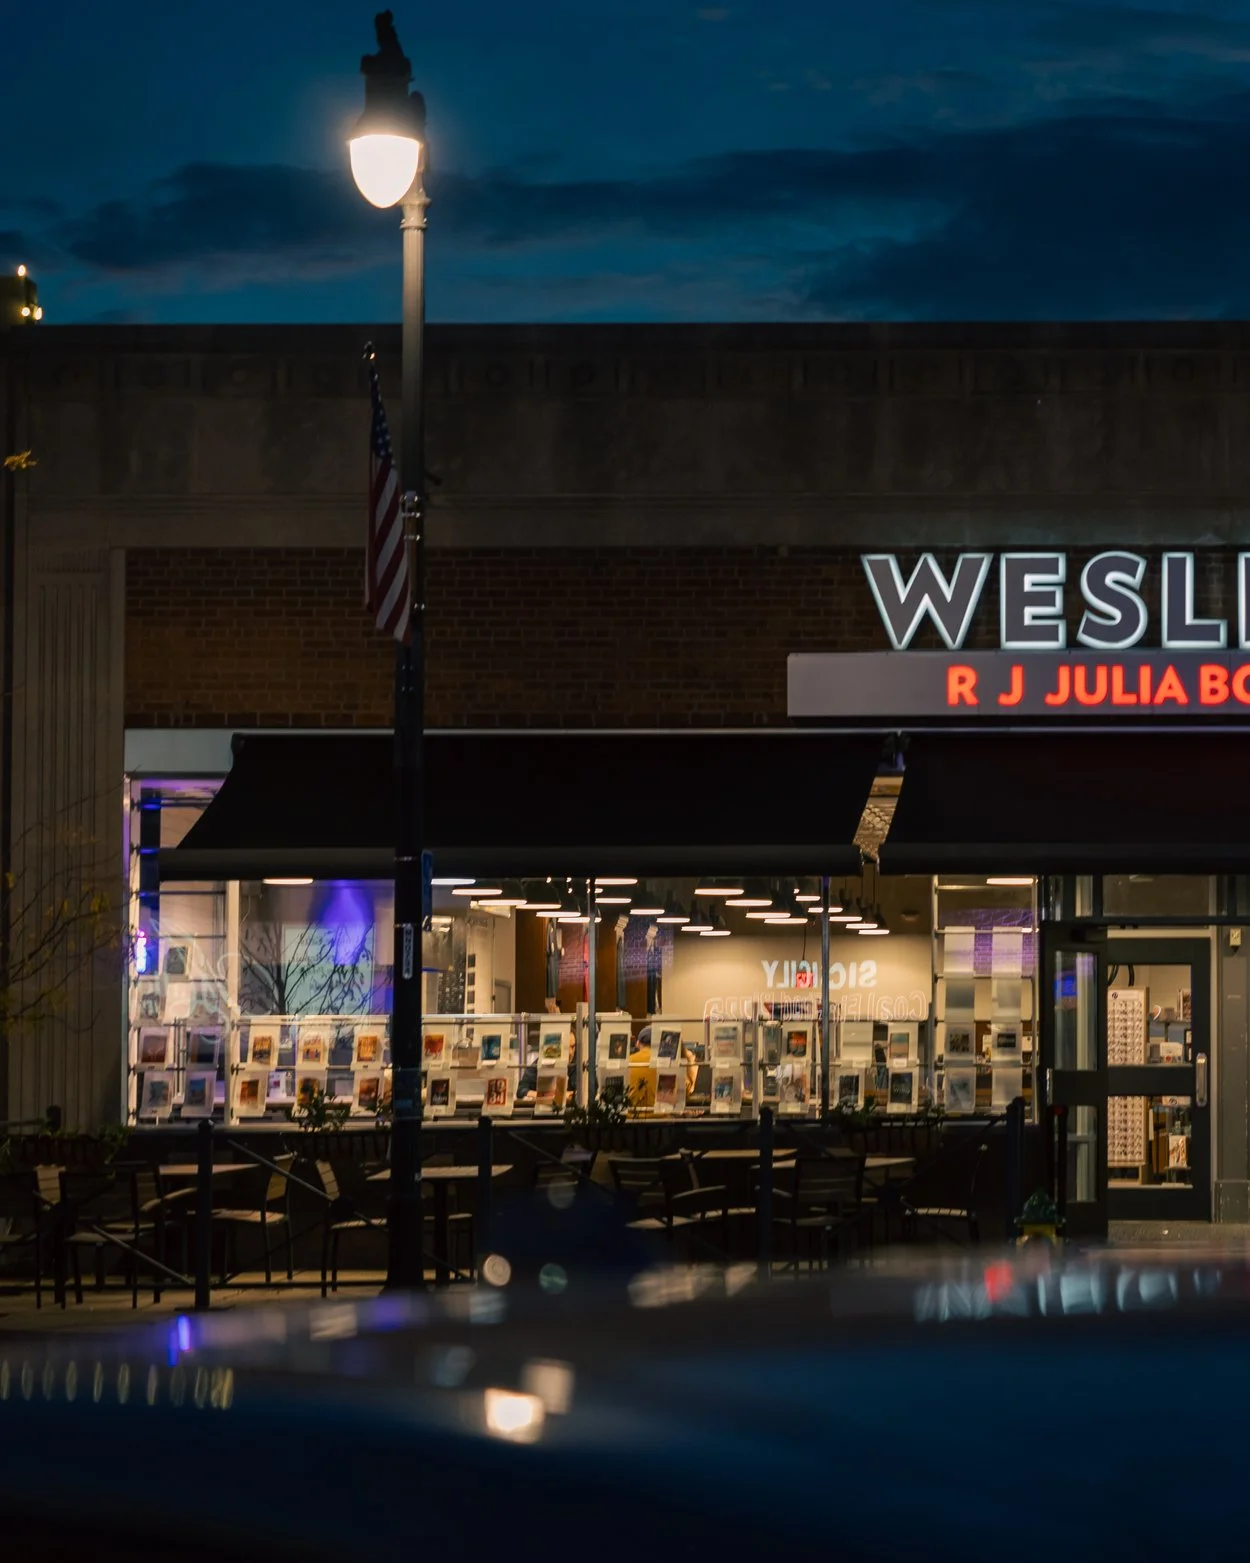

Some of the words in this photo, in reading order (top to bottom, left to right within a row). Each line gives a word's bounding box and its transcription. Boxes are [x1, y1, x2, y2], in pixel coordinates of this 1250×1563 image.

[947, 664, 978, 705] R
[997, 664, 1024, 705] J
[1044, 664, 1189, 705] JULIA
